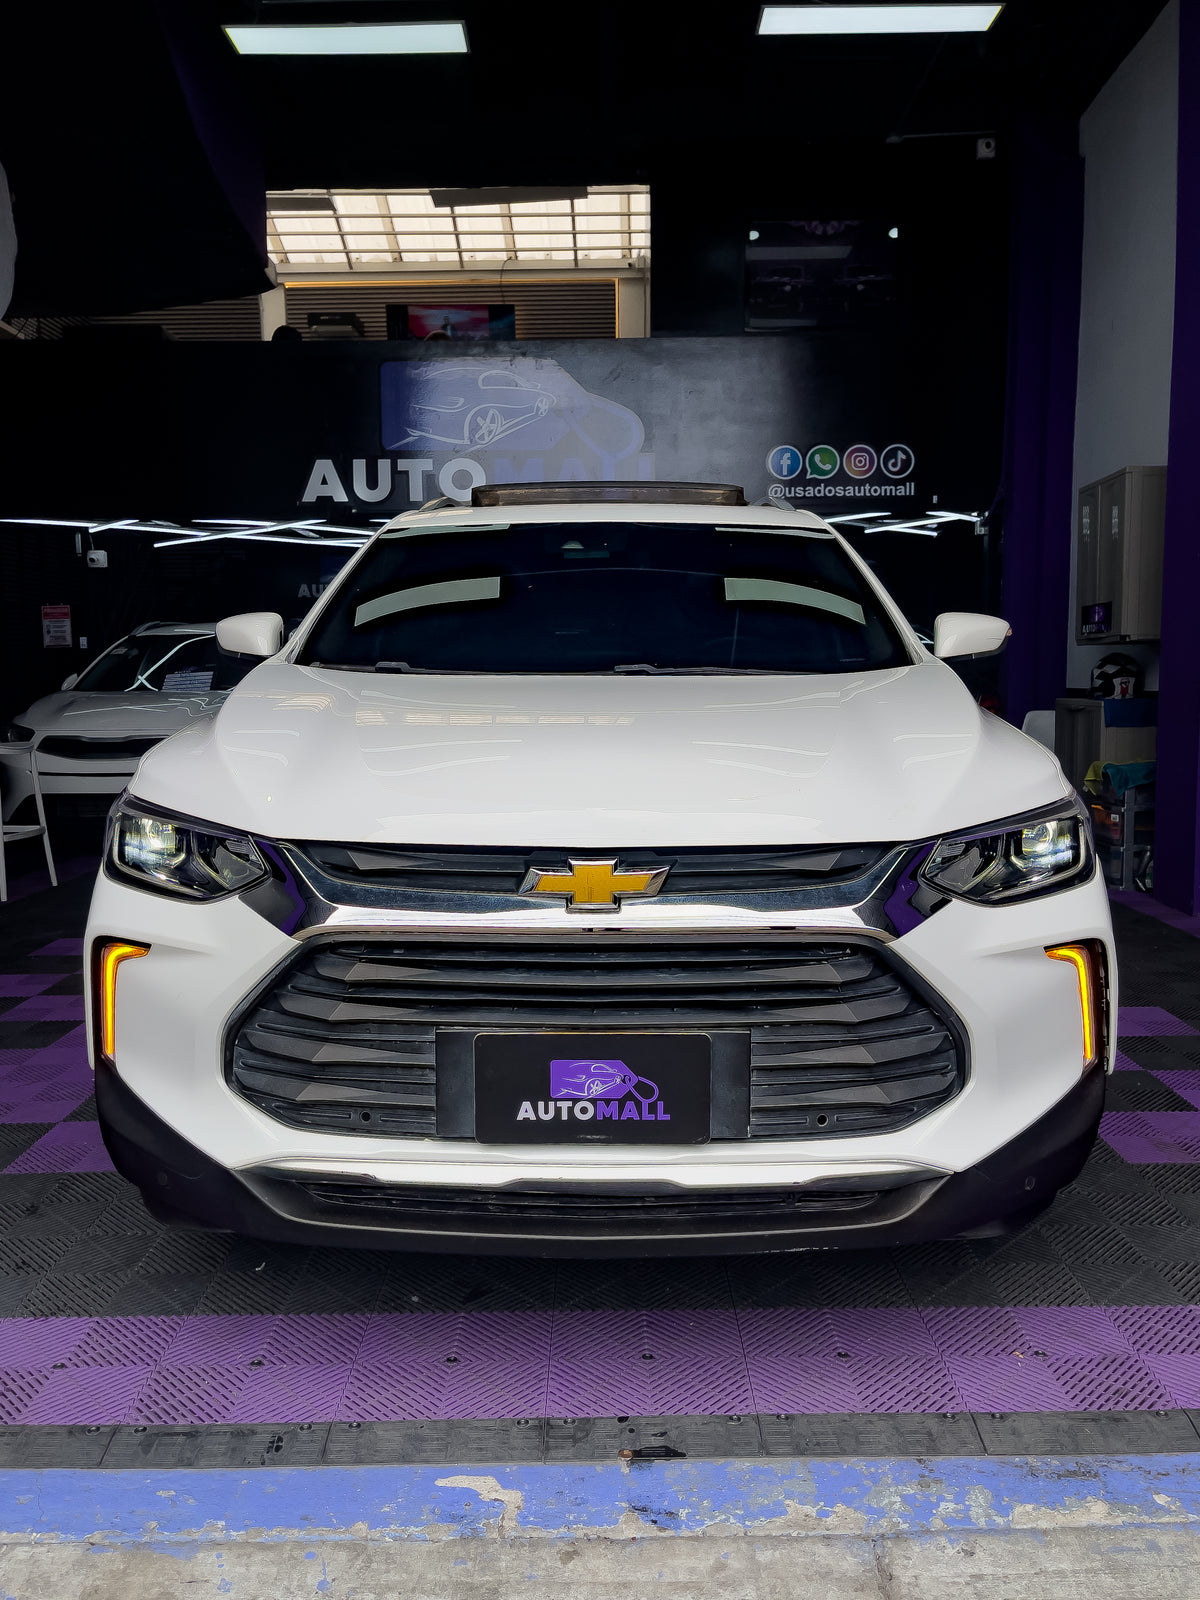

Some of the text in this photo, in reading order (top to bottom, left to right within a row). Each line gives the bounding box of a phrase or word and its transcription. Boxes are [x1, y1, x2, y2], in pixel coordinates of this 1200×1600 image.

[768, 482, 916, 499] @usadosautomall
[298, 583, 328, 598] AU
[516, 1101, 671, 1121] AUTOMALL
